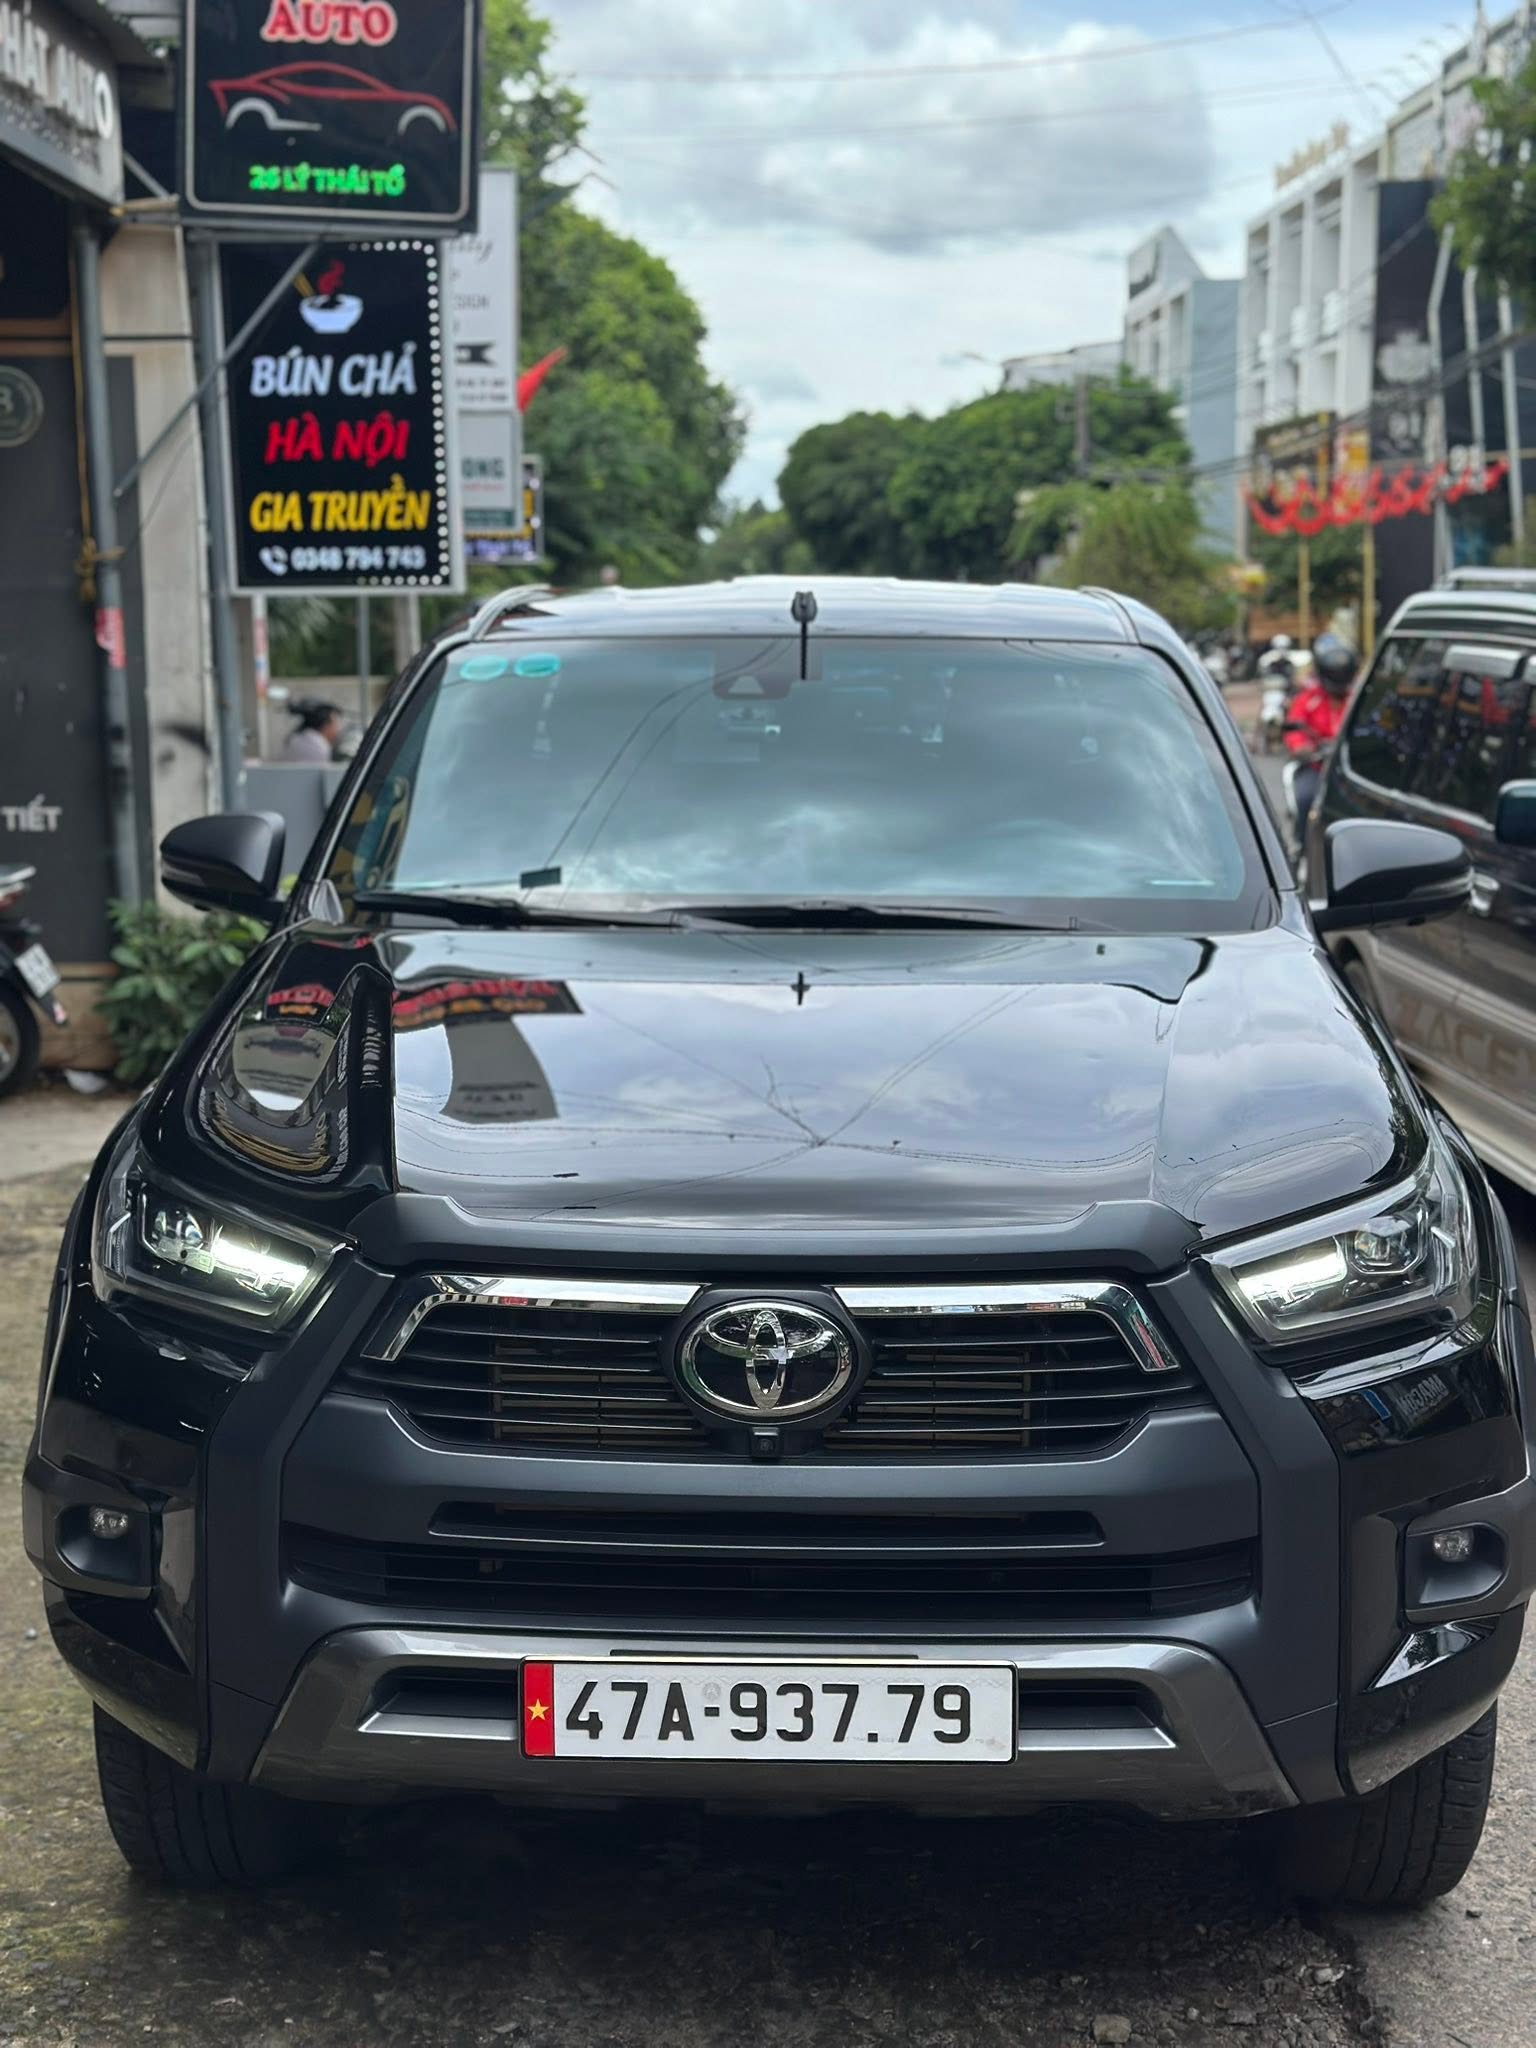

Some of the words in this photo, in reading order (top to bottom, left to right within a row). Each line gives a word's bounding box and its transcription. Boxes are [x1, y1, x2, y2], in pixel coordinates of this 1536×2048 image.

[260, 0, 398, 46] AUTO
[251, 346, 334, 397] BÚN
[338, 341, 417, 398] CHẢ
[264, 411, 324, 465] HÀ
[331, 410, 410, 468] NỘI
[250, 491, 304, 532] GIA
[308, 473, 431, 532] TRUYỀN
[565, 1681, 971, 1744] 47A-937.79
